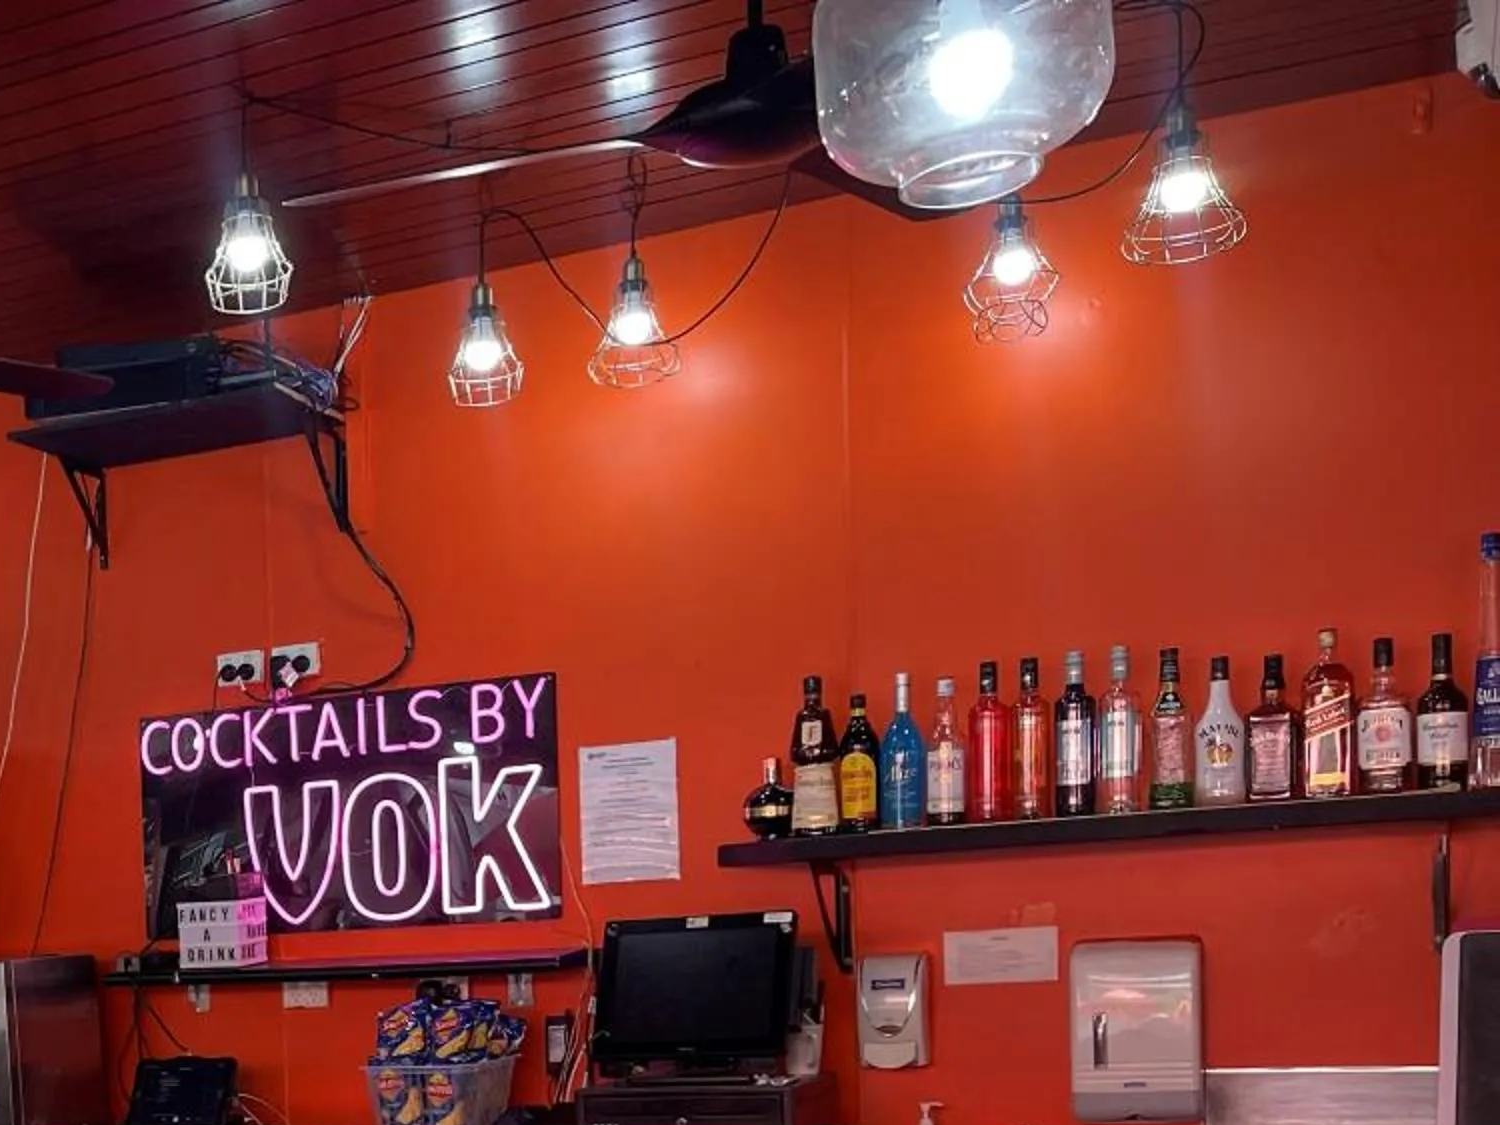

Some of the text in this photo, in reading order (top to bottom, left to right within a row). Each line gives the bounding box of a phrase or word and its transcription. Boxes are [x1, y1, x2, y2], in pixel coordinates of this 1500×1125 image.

[141, 676, 547, 776] COCKTAILS BY
[243, 756, 553, 925] VOK
[180, 908, 228, 922] FANCY
[203, 928, 211, 942] A
[188, 948, 235, 961] DRINK
